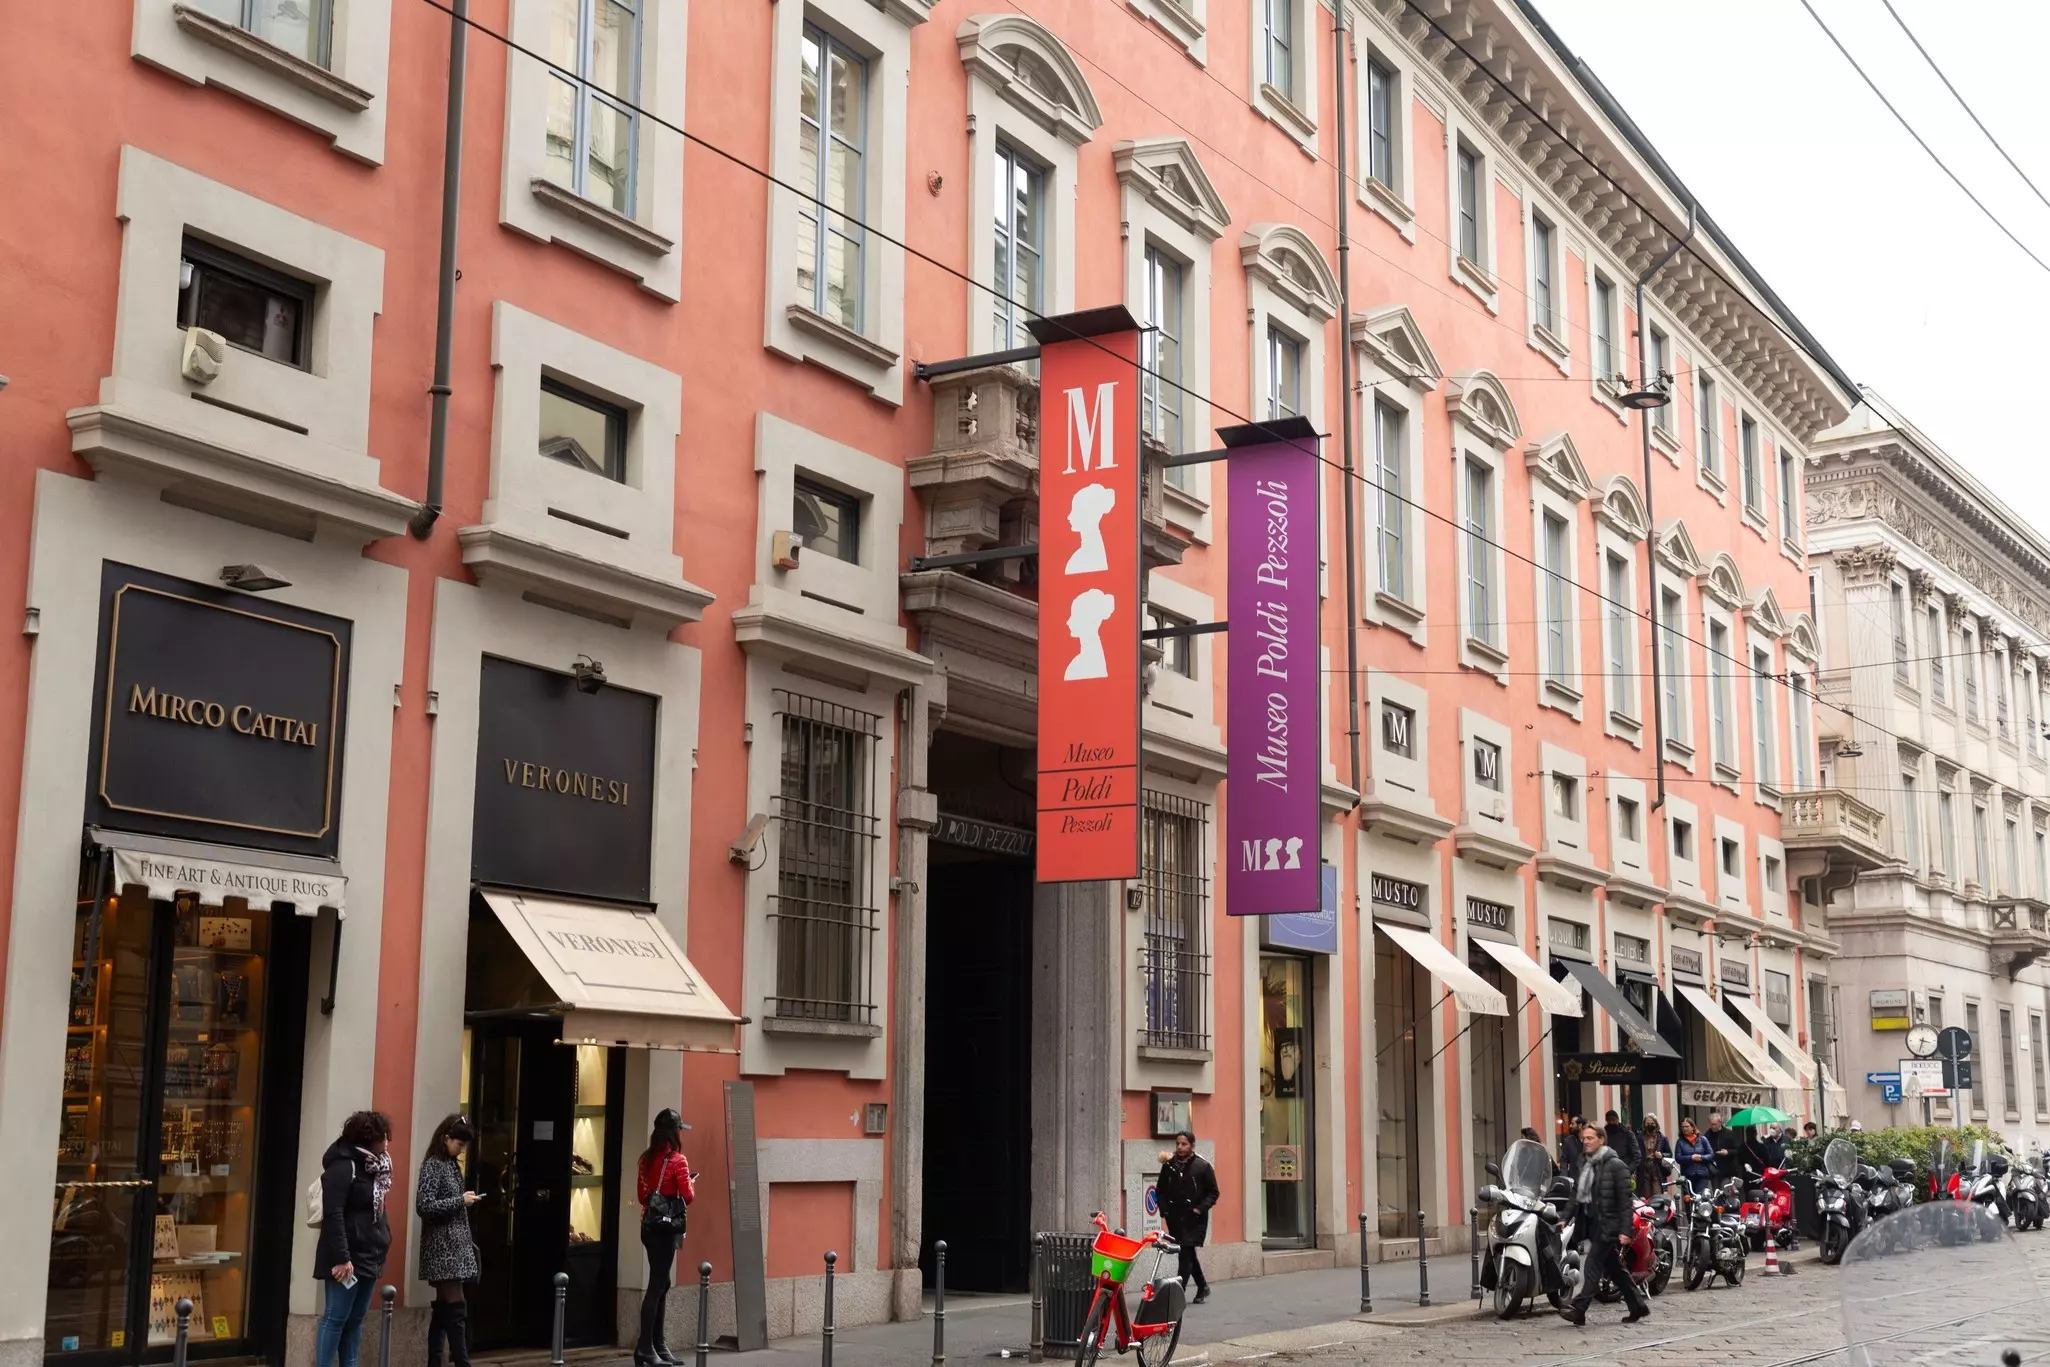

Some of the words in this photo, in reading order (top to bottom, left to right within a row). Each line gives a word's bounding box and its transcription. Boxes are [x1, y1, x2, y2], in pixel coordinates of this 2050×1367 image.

[1062, 381, 1119, 475] M
[1256, 480, 1289, 590] Pezzoli
[1256, 601, 1289, 683] Poldi
[128, 683, 226, 728] MIRCO
[230, 704, 318, 746] CATTAI
[1390, 712, 1408, 748] M
[1062, 742, 1115, 764] Museo
[1256, 691, 1289, 793] Museo
[1483, 748, 1497, 780] M
[503, 757, 629, 806] VERONESI
[1060, 774, 1114, 803] Poldi
[946, 820, 984, 847] POLDI
[984, 828, 1034, 856] PEZZOLI
[1060, 811, 1114, 835] Pezzoli
[1242, 839, 1263, 872] M
[140, 859, 174, 880] FINE
[178, 865, 207, 884] ART
[210, 868, 222, 886] &
[225, 871, 288, 896] ANTIQUE
[292, 878, 329, 898] RUGS
[1372, 876, 1419, 907] MUSTO
[1466, 900, 1507, 927] MUSTO
[547, 930, 667, 960] VERONESI
[1586, 1059, 1636, 1074] Pineider
[1693, 1089, 1762, 1105] GELATERIA
